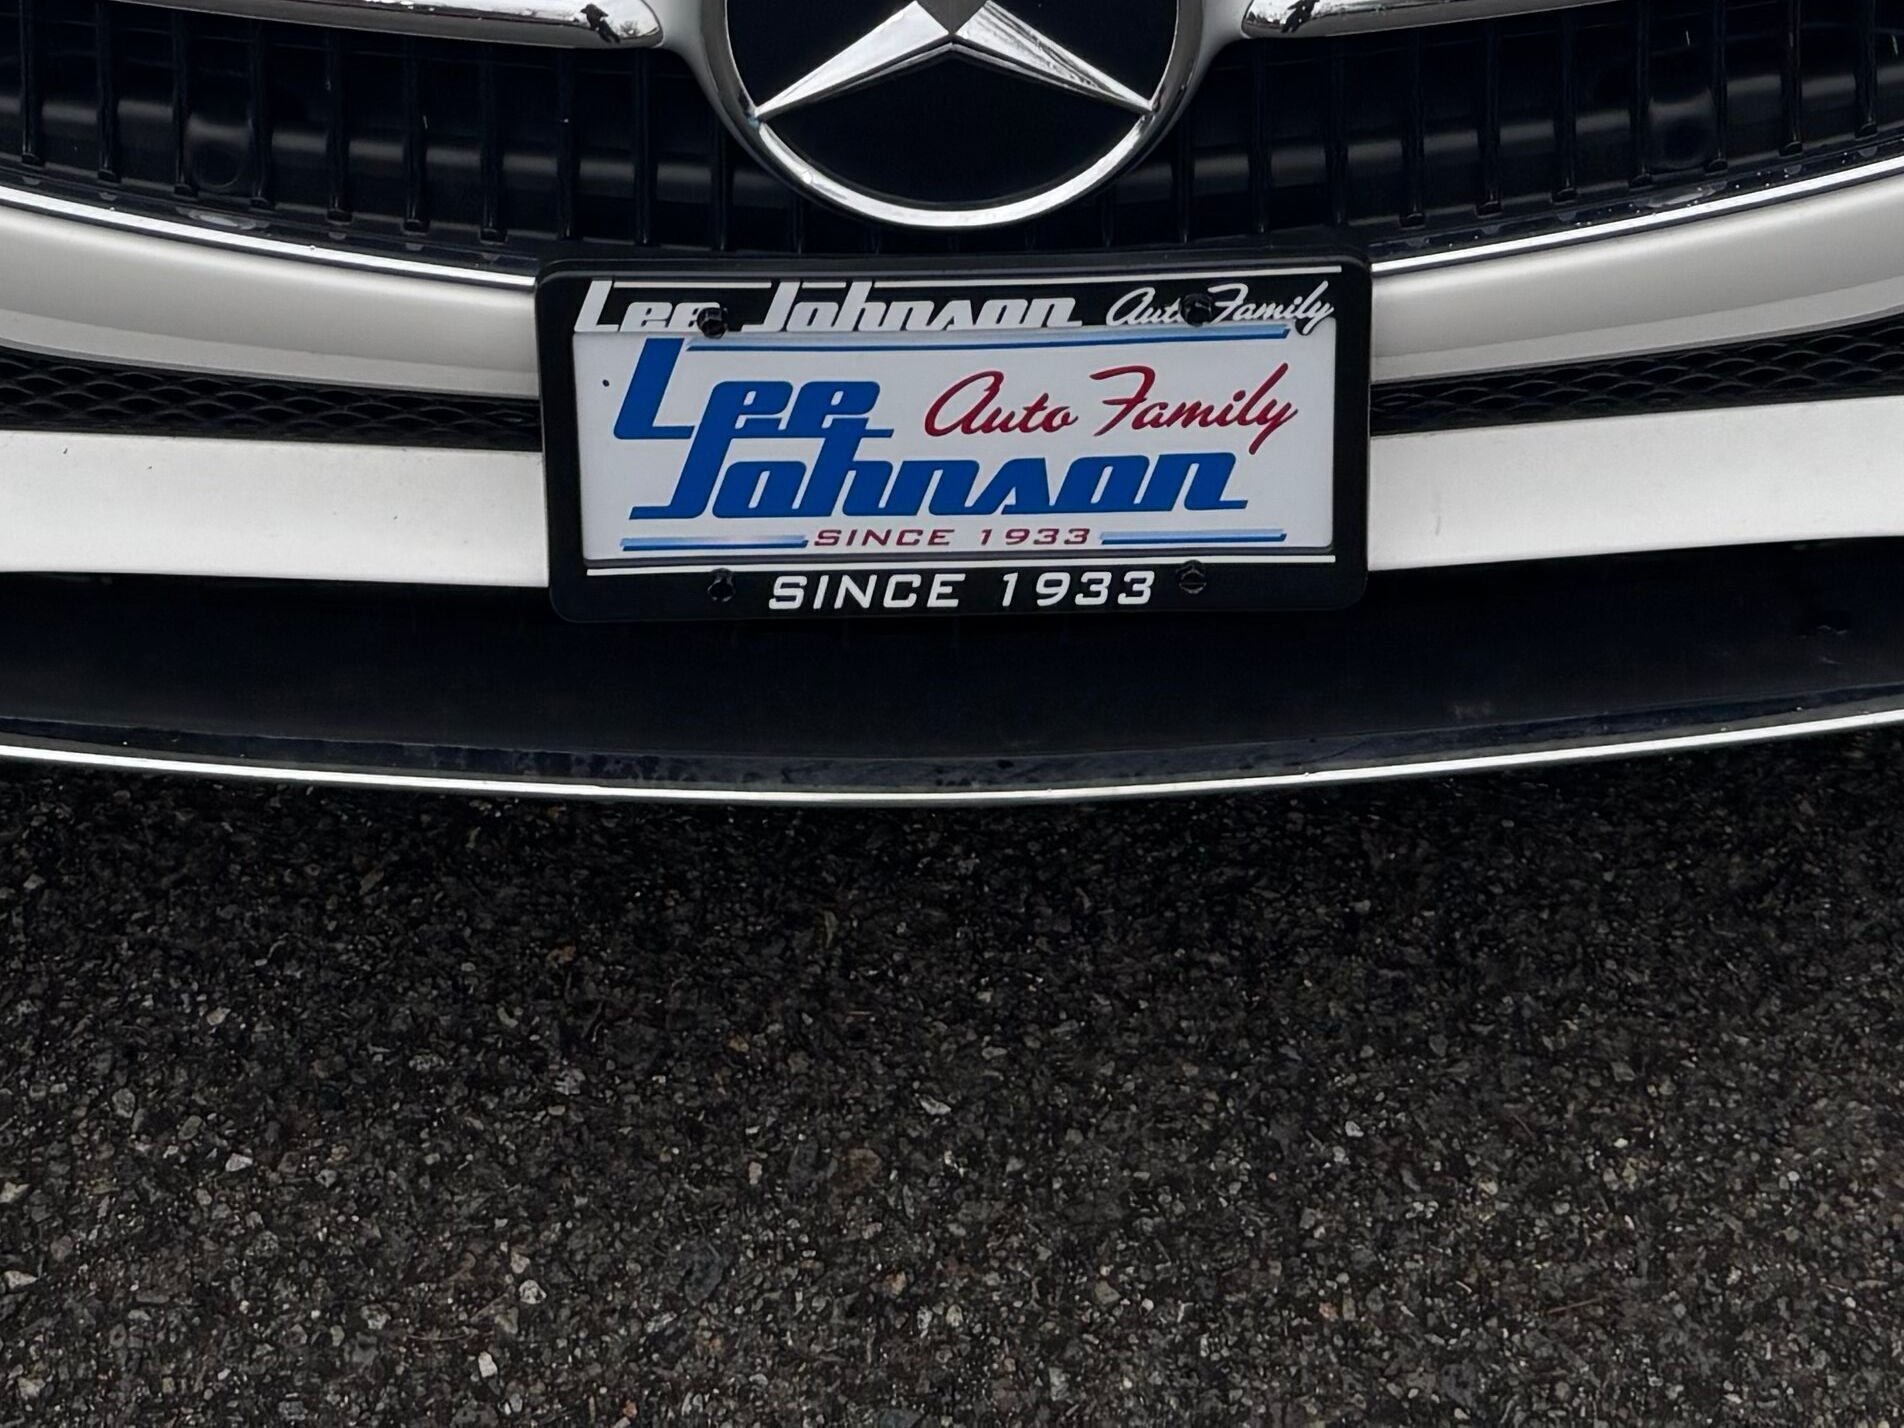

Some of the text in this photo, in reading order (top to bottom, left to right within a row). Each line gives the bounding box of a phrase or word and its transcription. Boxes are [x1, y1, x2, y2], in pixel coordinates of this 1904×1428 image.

[741, 280, 1082, 332] Johnson
[1106, 287, 1192, 325] Aut
[1207, 280, 1335, 334] Family
[613, 338, 894, 439] Lee
[924, 362, 1299, 455] Auto Family
[629, 436, 1248, 520] Johnson
[814, 528, 1091, 547] SINCE 1933
[768, 570, 1156, 610] SINCE 1933
